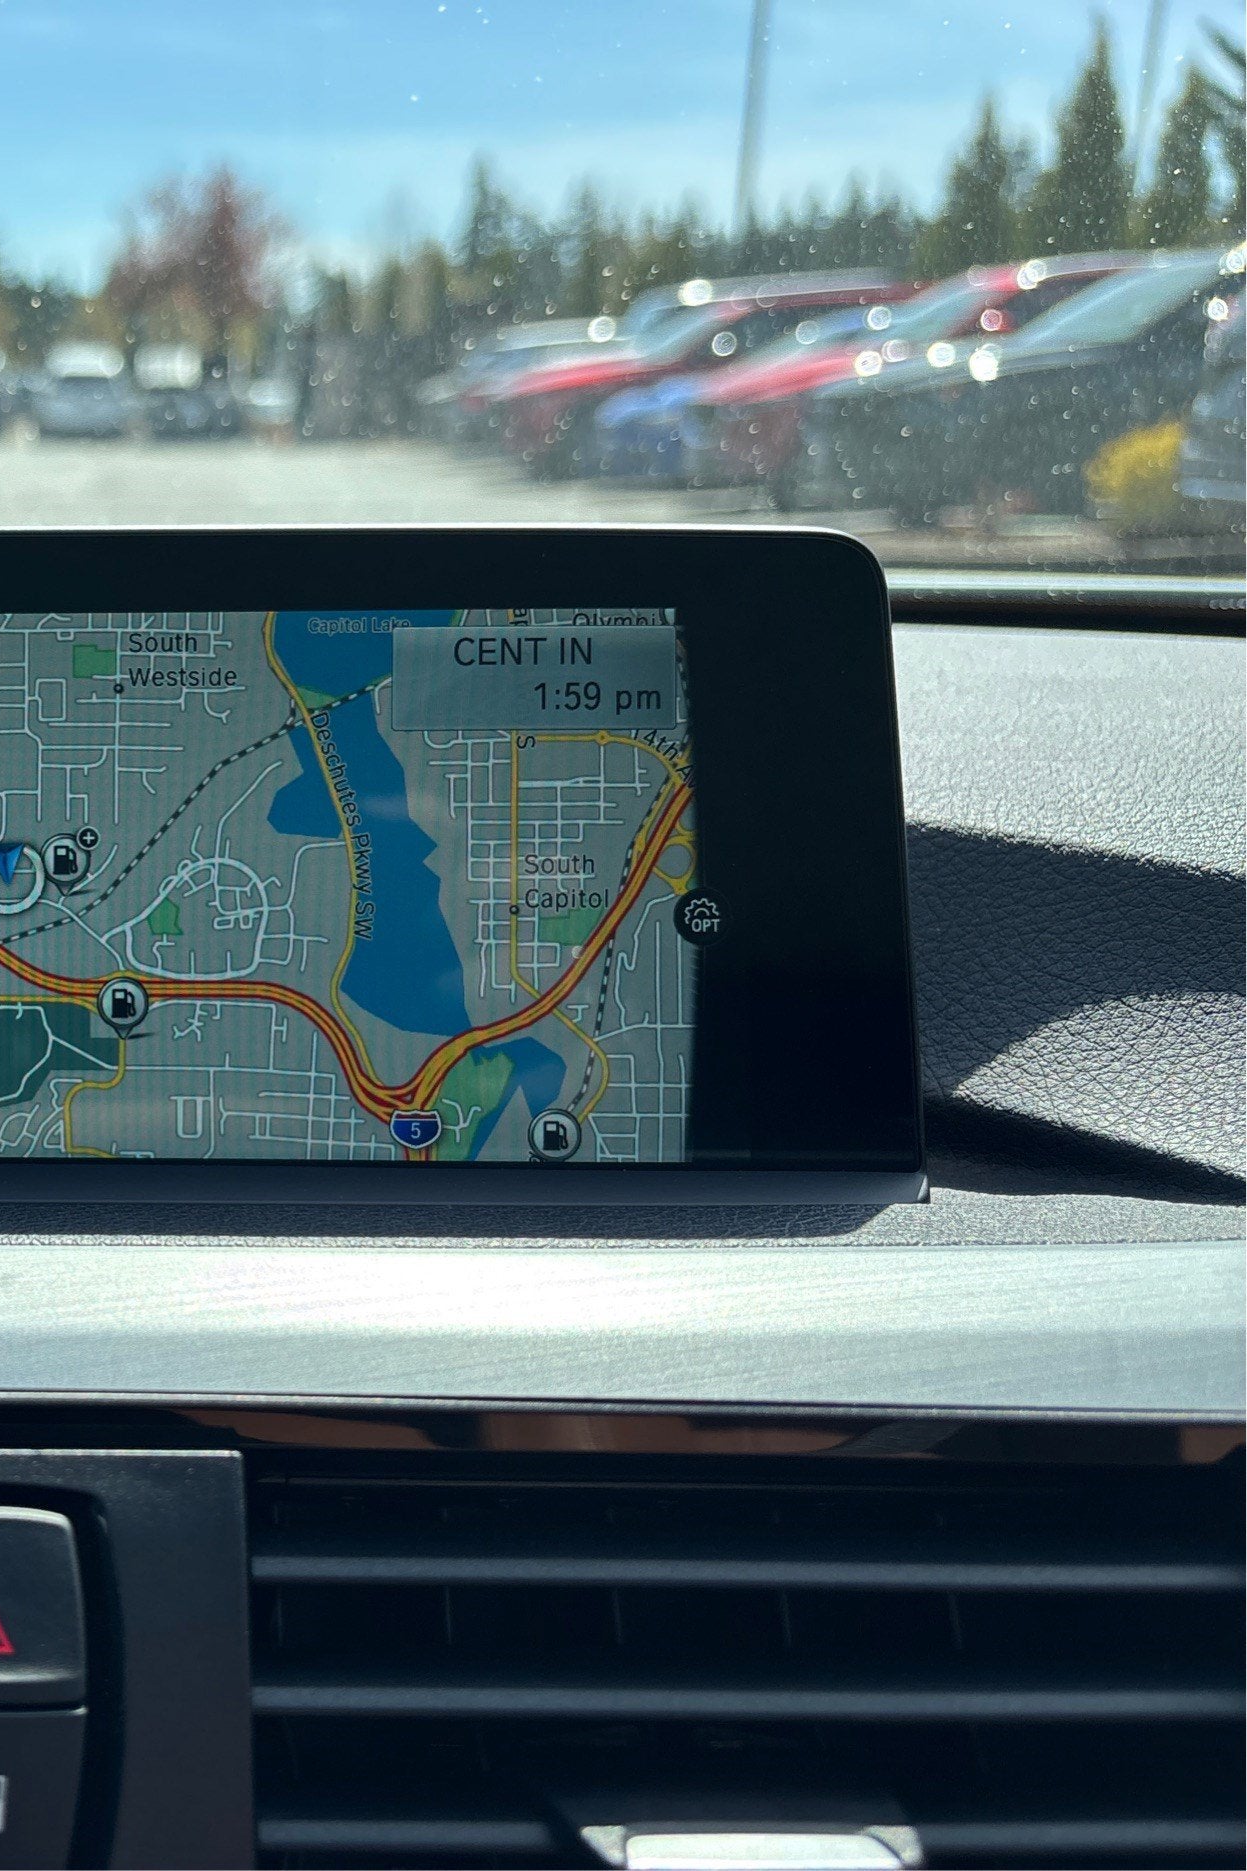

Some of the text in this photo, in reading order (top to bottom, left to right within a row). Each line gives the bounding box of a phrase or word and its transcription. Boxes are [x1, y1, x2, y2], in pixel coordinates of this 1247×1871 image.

[308, 617, 367, 636] Capitol
[129, 633, 198, 653] South
[453, 637, 593, 665] CENT IN
[128, 667, 238, 687] Westside
[534, 681, 661, 715] 1:59 pm
[311, 711, 374, 939] Deschutes Pkwy SW
[524, 854, 596, 875] South
[524, 888, 610, 912] Capitol
[691, 918, 720, 933] OPT
[410, 1121, 422, 1140] 5
